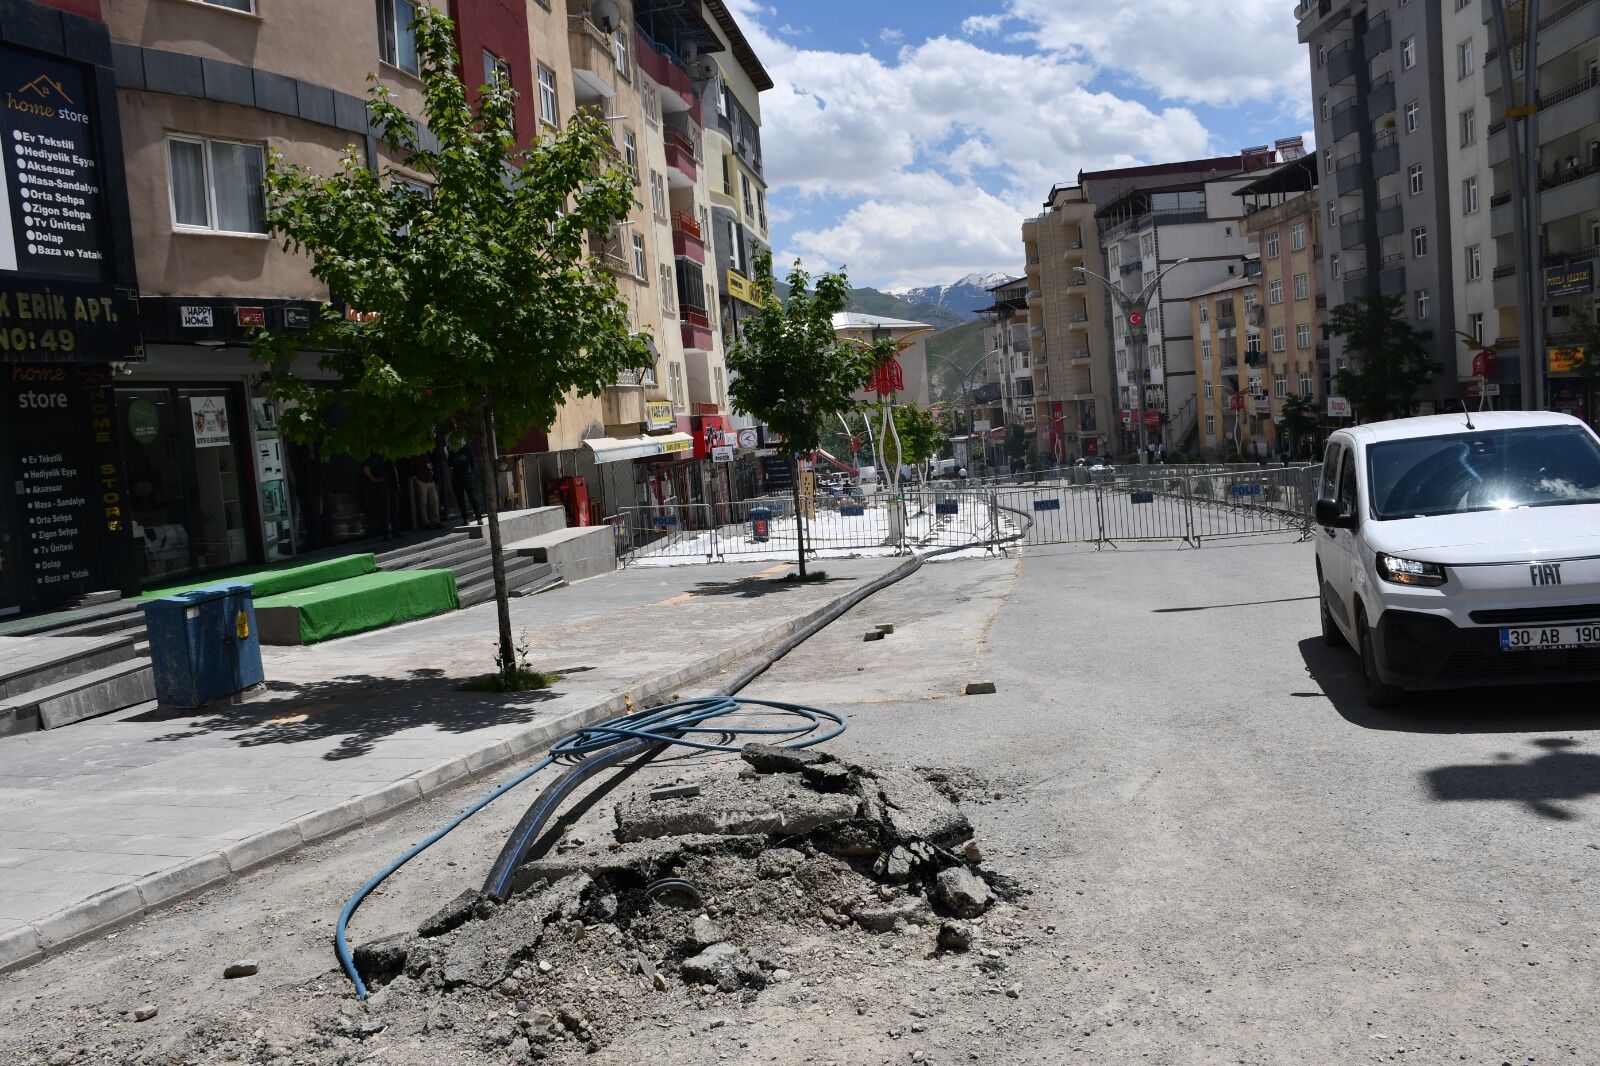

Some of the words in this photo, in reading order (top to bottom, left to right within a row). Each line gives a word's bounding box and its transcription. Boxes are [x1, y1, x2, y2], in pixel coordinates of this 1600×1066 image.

[6, 92, 55, 117] home
[59, 108, 89, 124] store
[22, 131, 36, 143] Ev
[37, 135, 75, 150] Tekstili
[24, 146, 70, 162] Hediyelik
[72, 154, 95, 168] Eşya
[27, 160, 76, 176] Aksesuar
[30, 189, 53, 201] Orta
[55, 192, 85, 206] Sehpa
[32, 203, 60, 217] Zigon
[62, 207, 92, 220] Sehpa
[33, 217, 47, 227] Tv
[49, 217, 86, 232] Ünitesi
[35, 231, 64, 245] Dolap
[37, 244, 62, 256] Baza
[63, 248, 75, 257] ve
[76, 248, 103, 260] Yatak
[16, 287, 67, 320] ERİK
[75, 296, 118, 322] APT.
[187, 307, 211, 317] HAPPY
[185, 316, 209, 326] HOME
[18, 389, 69, 409] store
[38, 453, 63, 463] Tekstili
[32, 483, 63, 494] Aksesuar
[52, 513, 73, 524] Sehpa
[58, 527, 78, 538] Sehpa
[42, 560, 62, 570] Dolap
[1529, 563, 1562, 586] FIAT
[1510, 629, 1530, 645] 30
[1540, 629, 1560, 644] AB
[1576, 626, 1600, 643] 190
